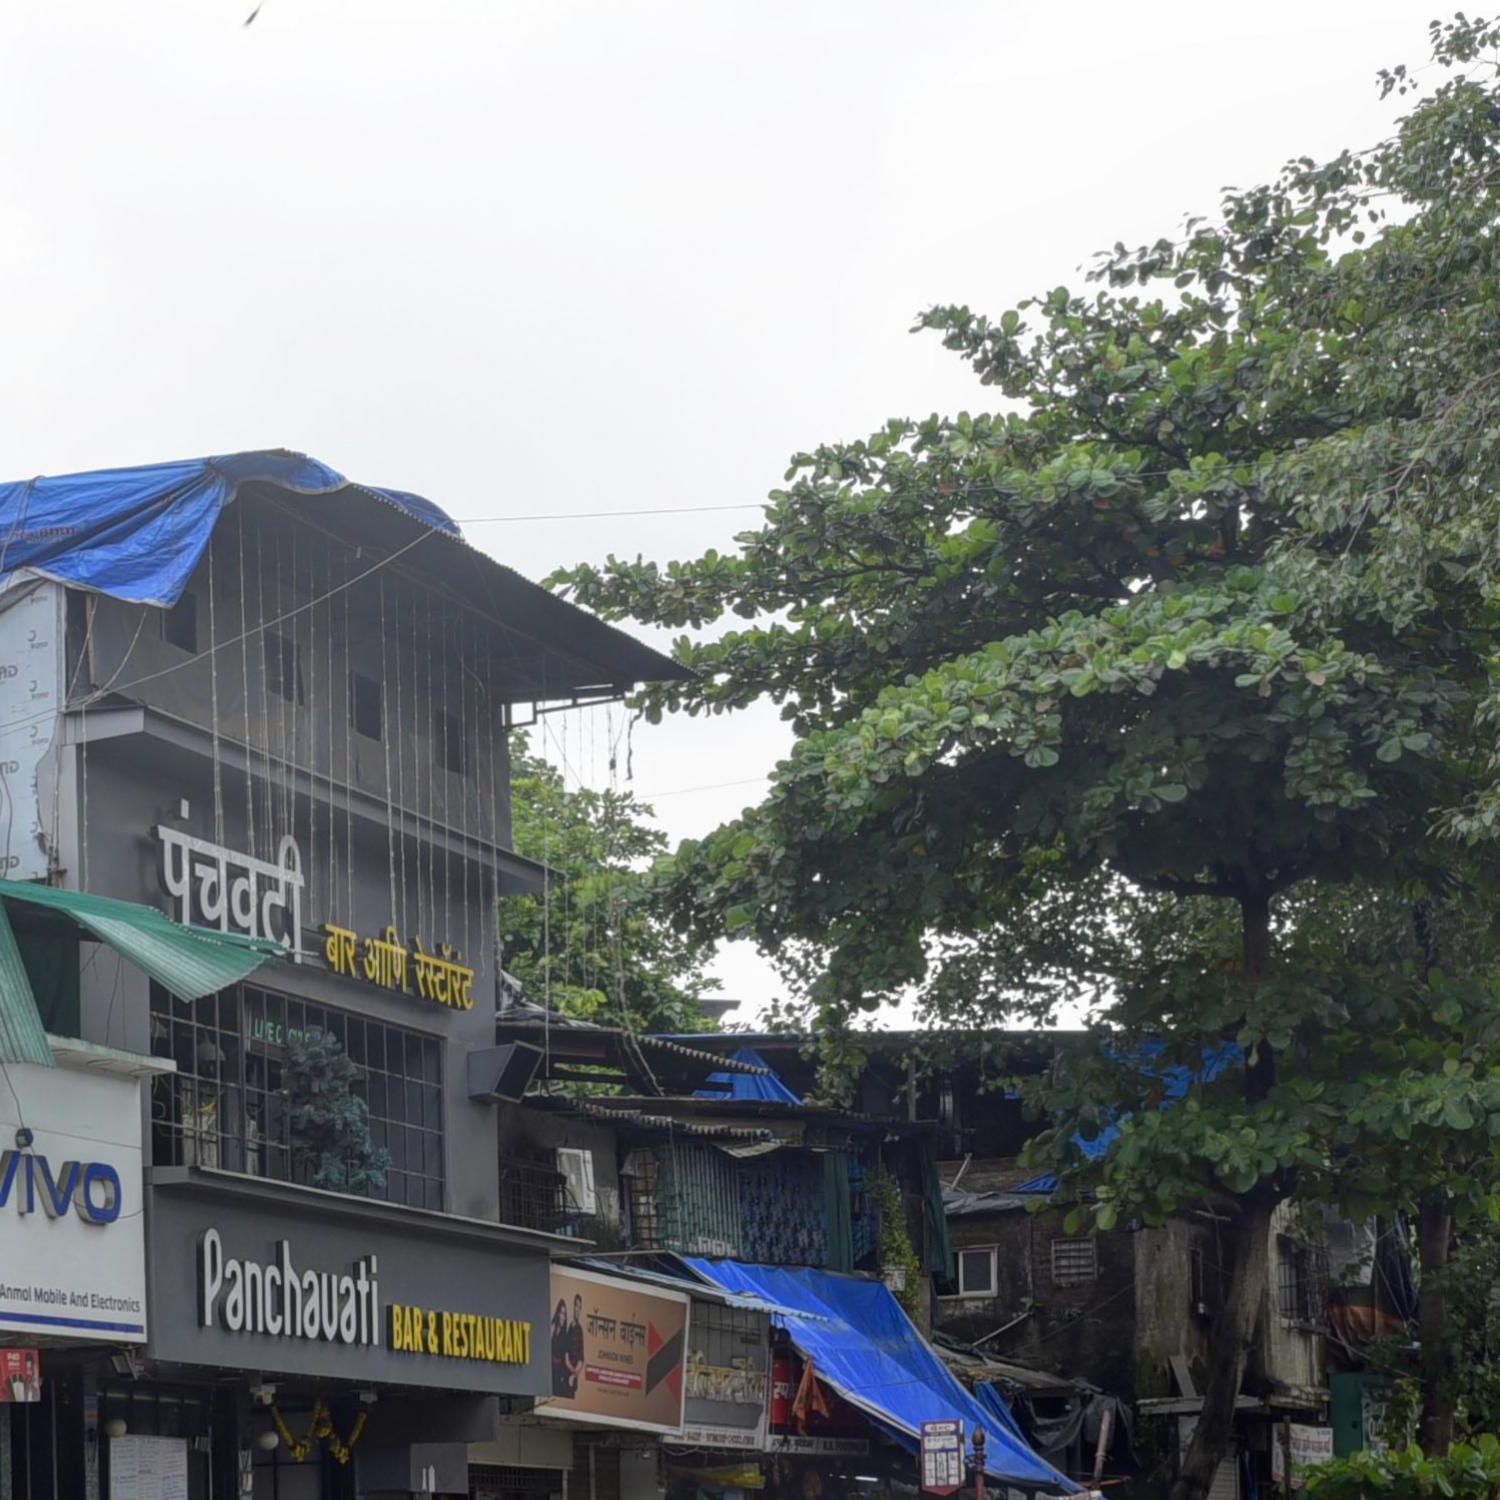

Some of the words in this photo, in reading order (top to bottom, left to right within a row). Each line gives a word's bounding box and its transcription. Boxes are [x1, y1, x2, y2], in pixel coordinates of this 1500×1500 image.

[155, 799, 305, 963] पंचवटी
[326, 923, 357, 977] बार
[364, 925, 408, 992] आणि
[0, 1283, 31, 1302] Anmol
[34, 1287, 67, 1306] Mobile
[69, 1291, 88, 1307] And
[91, 1294, 140, 1314] Electronics
[197, 1227, 379, 1346] Panchavati
[388, 1304, 423, 1353] BAR
[426, 1311, 439, 1354] &
[441, 1311, 532, 1365] RESTAURANT
